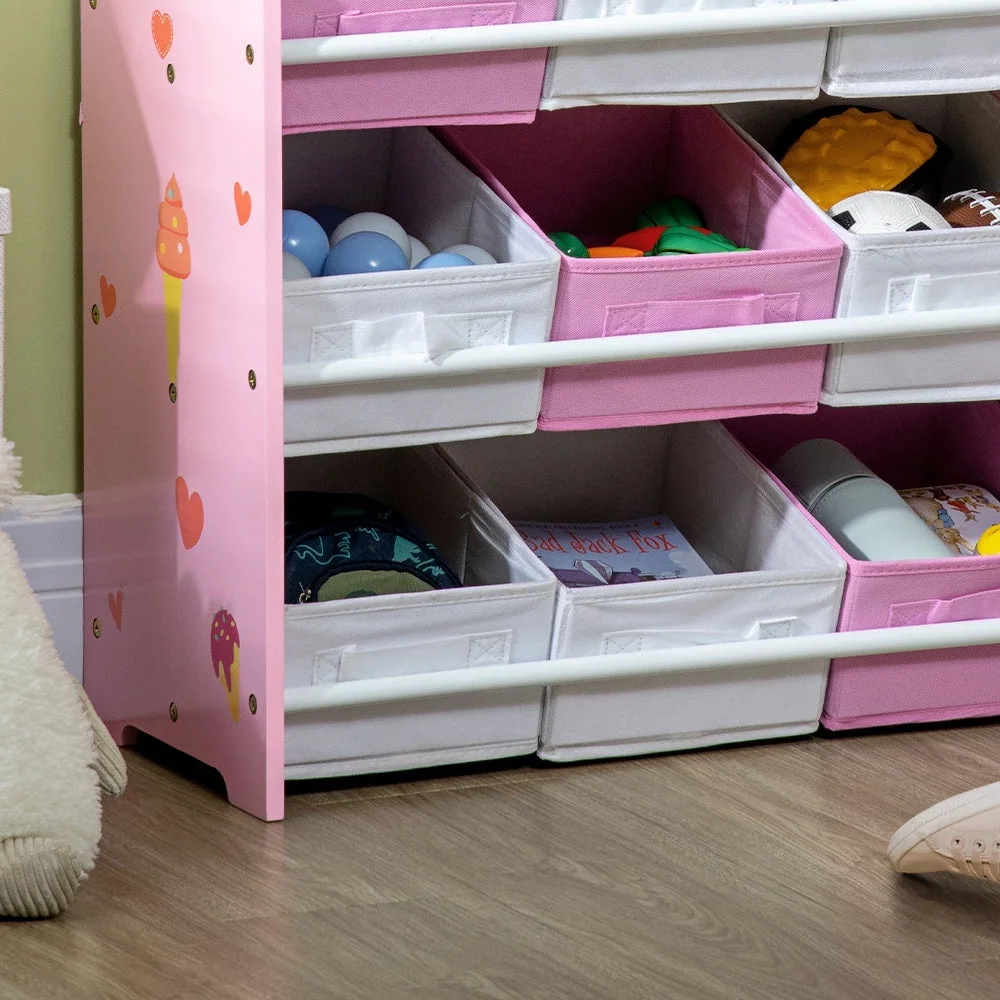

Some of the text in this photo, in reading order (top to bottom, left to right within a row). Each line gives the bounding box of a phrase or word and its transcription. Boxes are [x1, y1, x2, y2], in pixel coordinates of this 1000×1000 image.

[518, 530, 678, 555] Bad Jack Fox
